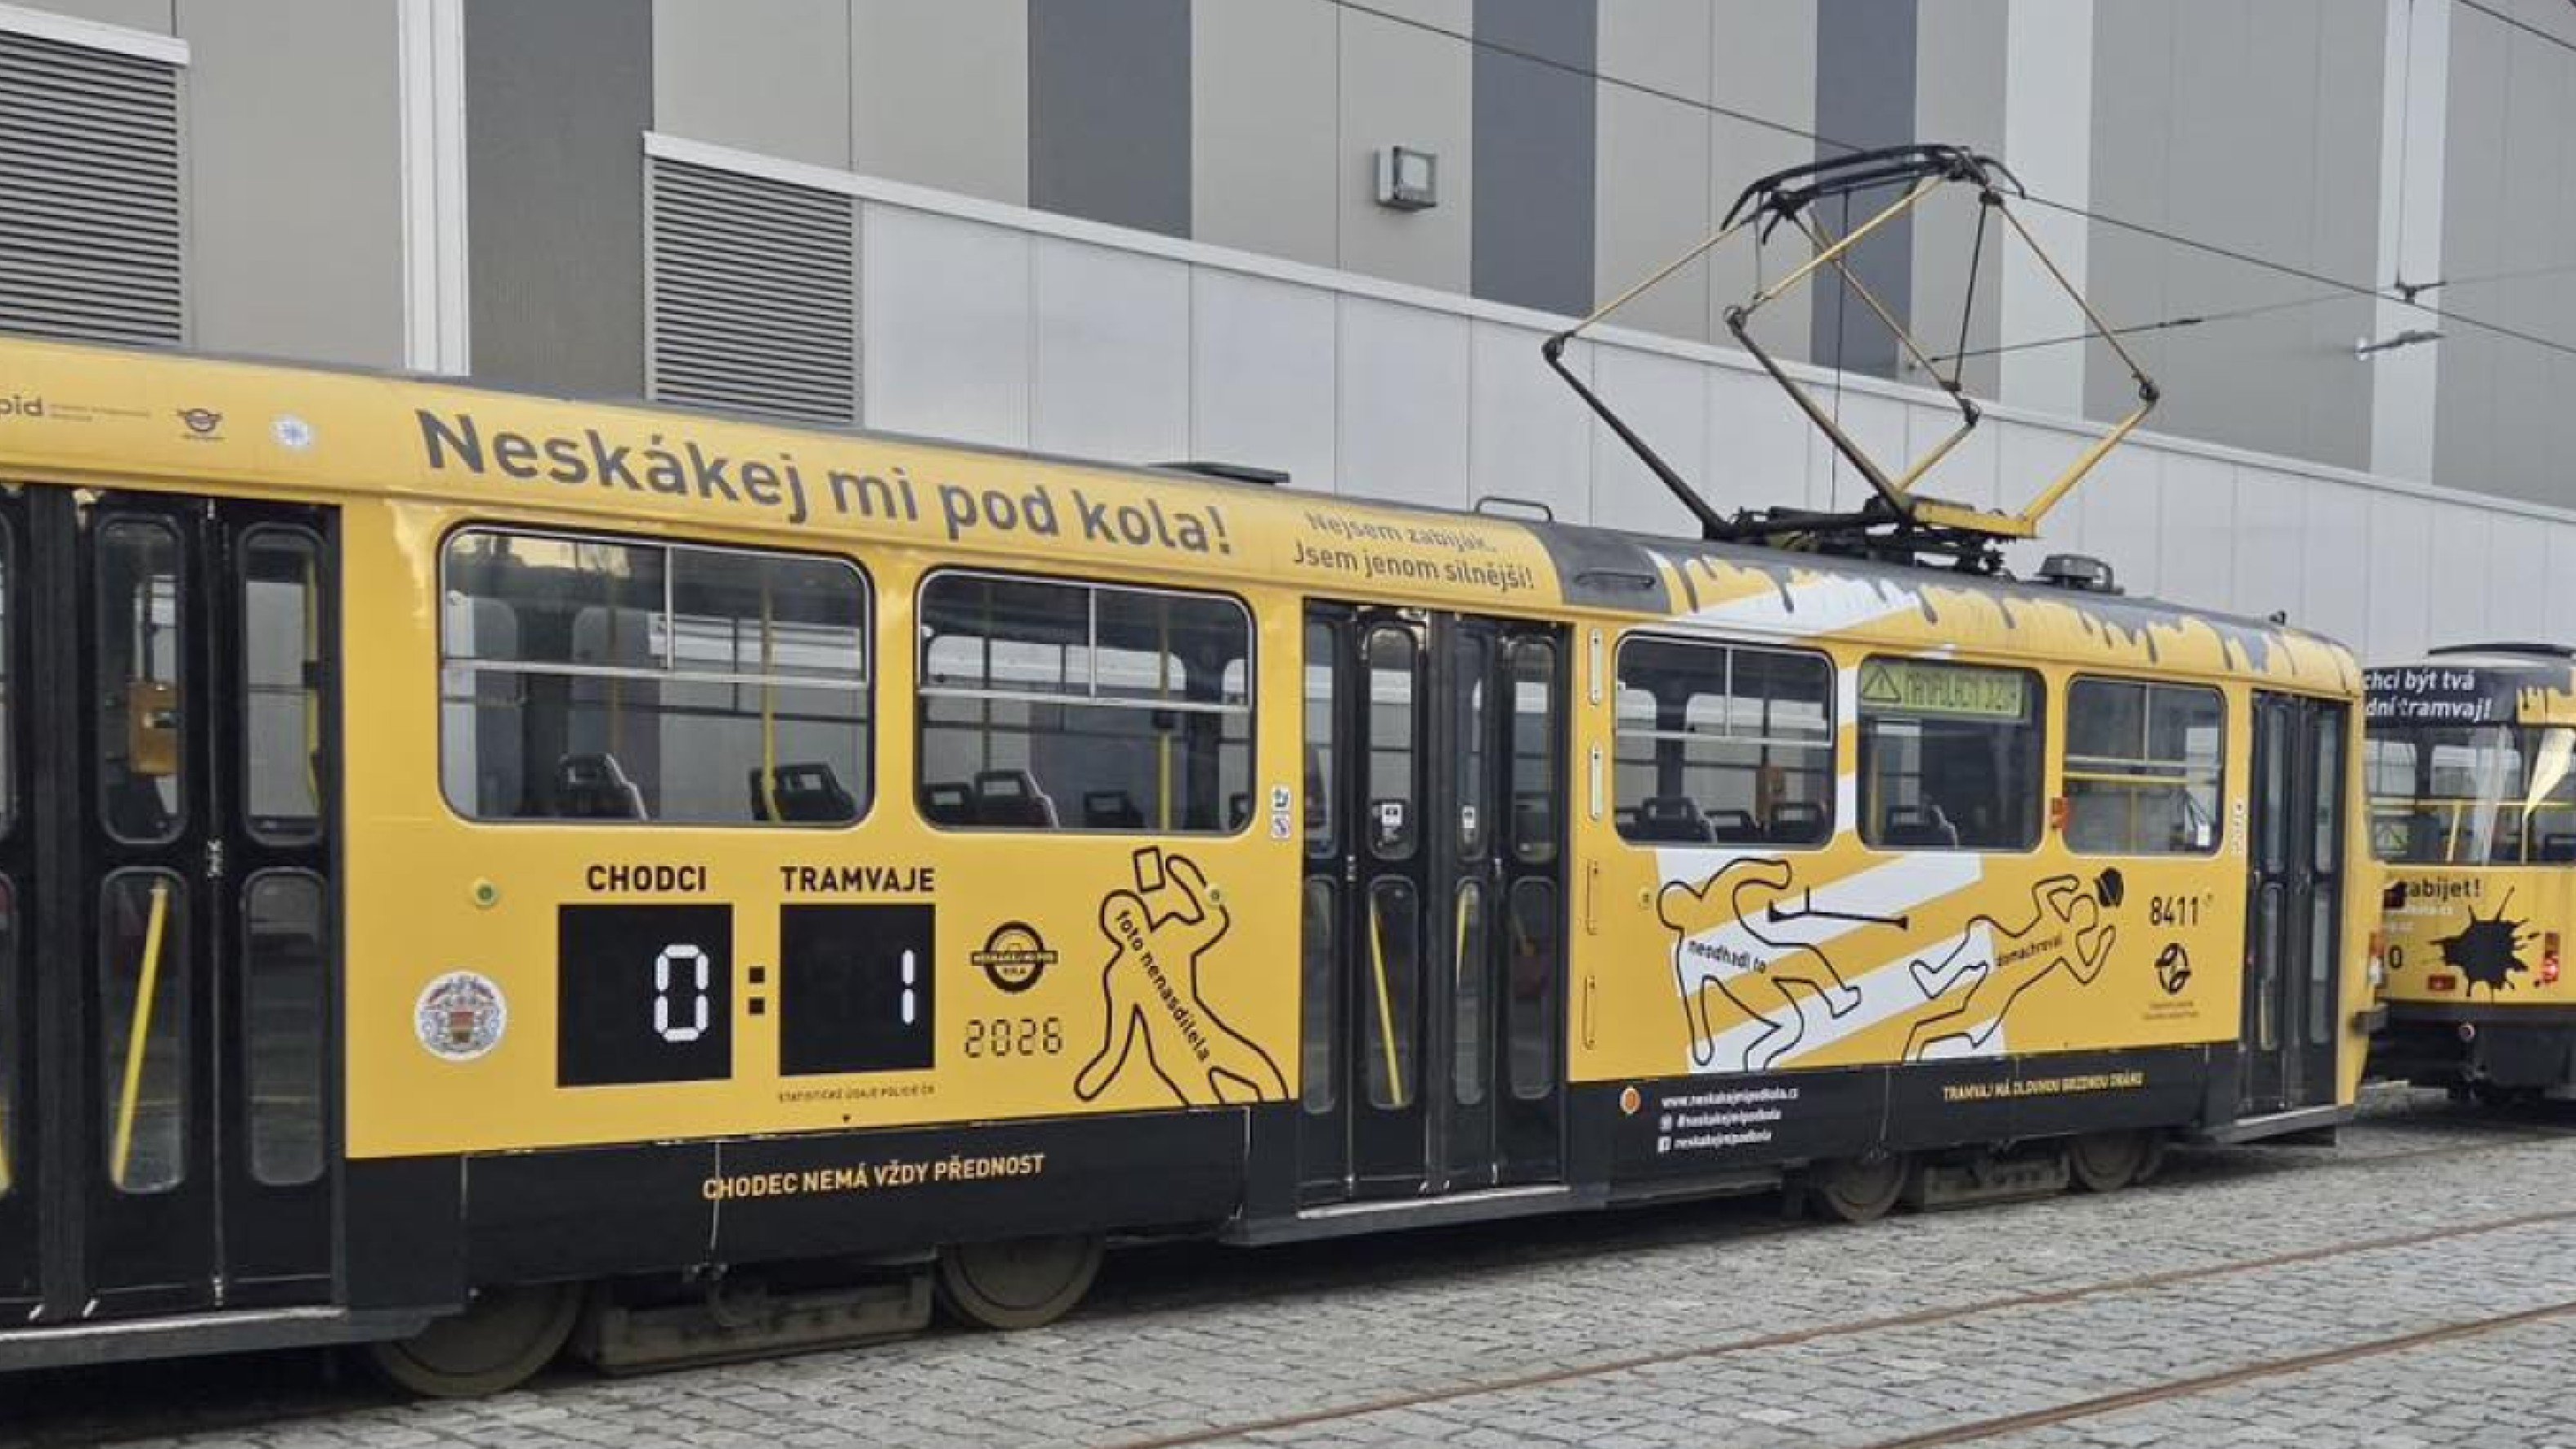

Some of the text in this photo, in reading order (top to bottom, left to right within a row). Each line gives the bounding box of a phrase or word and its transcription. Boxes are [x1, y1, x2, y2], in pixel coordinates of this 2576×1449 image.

[417, 409, 1230, 554] Neskákej mi pod kola!
[1295, 538, 1358, 572] Jsem
[1364, 549, 1440, 578] jenom
[2363, 667, 2475, 694] chci být tvá
[2399, 697, 2492, 722] tramvaj!
[587, 865, 707, 892] CHODCI
[780, 865, 936, 892] TRAMVAJE
[2405, 876, 2480, 901] abijet!
[2149, 896, 2199, 927] 8411
[1116, 910, 1143, 951] foto
[655, 943, 709, 1042] 0
[901, 949, 916, 1026] 1
[964, 1017, 1063, 1058] 2026
[703, 1152, 1046, 1200] CHODEC NEMÁ VŽDY PŘEDNOST
